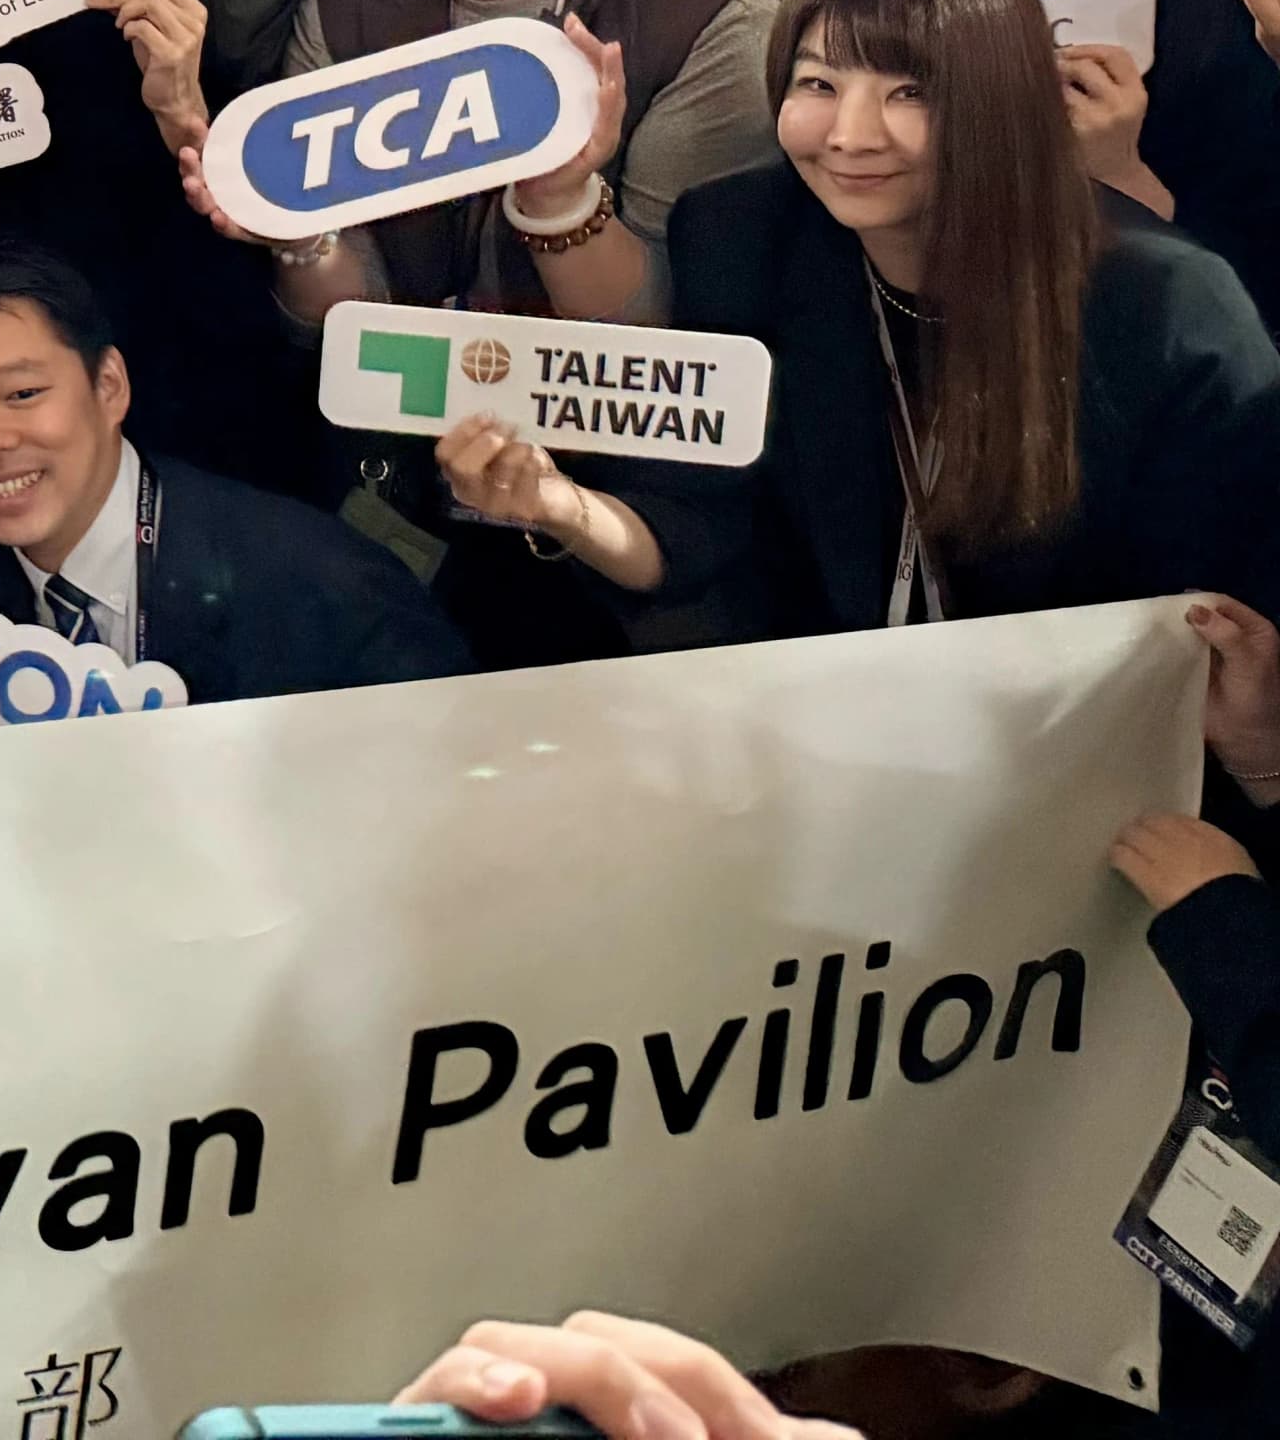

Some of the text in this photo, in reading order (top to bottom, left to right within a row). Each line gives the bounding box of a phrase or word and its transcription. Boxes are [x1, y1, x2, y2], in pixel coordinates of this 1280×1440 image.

[290, 68, 501, 192] TCA
[534, 346, 719, 397] TALENT
[530, 391, 725, 446] TAIWAN
[390, 941, 1088, 1185] Pavilion
